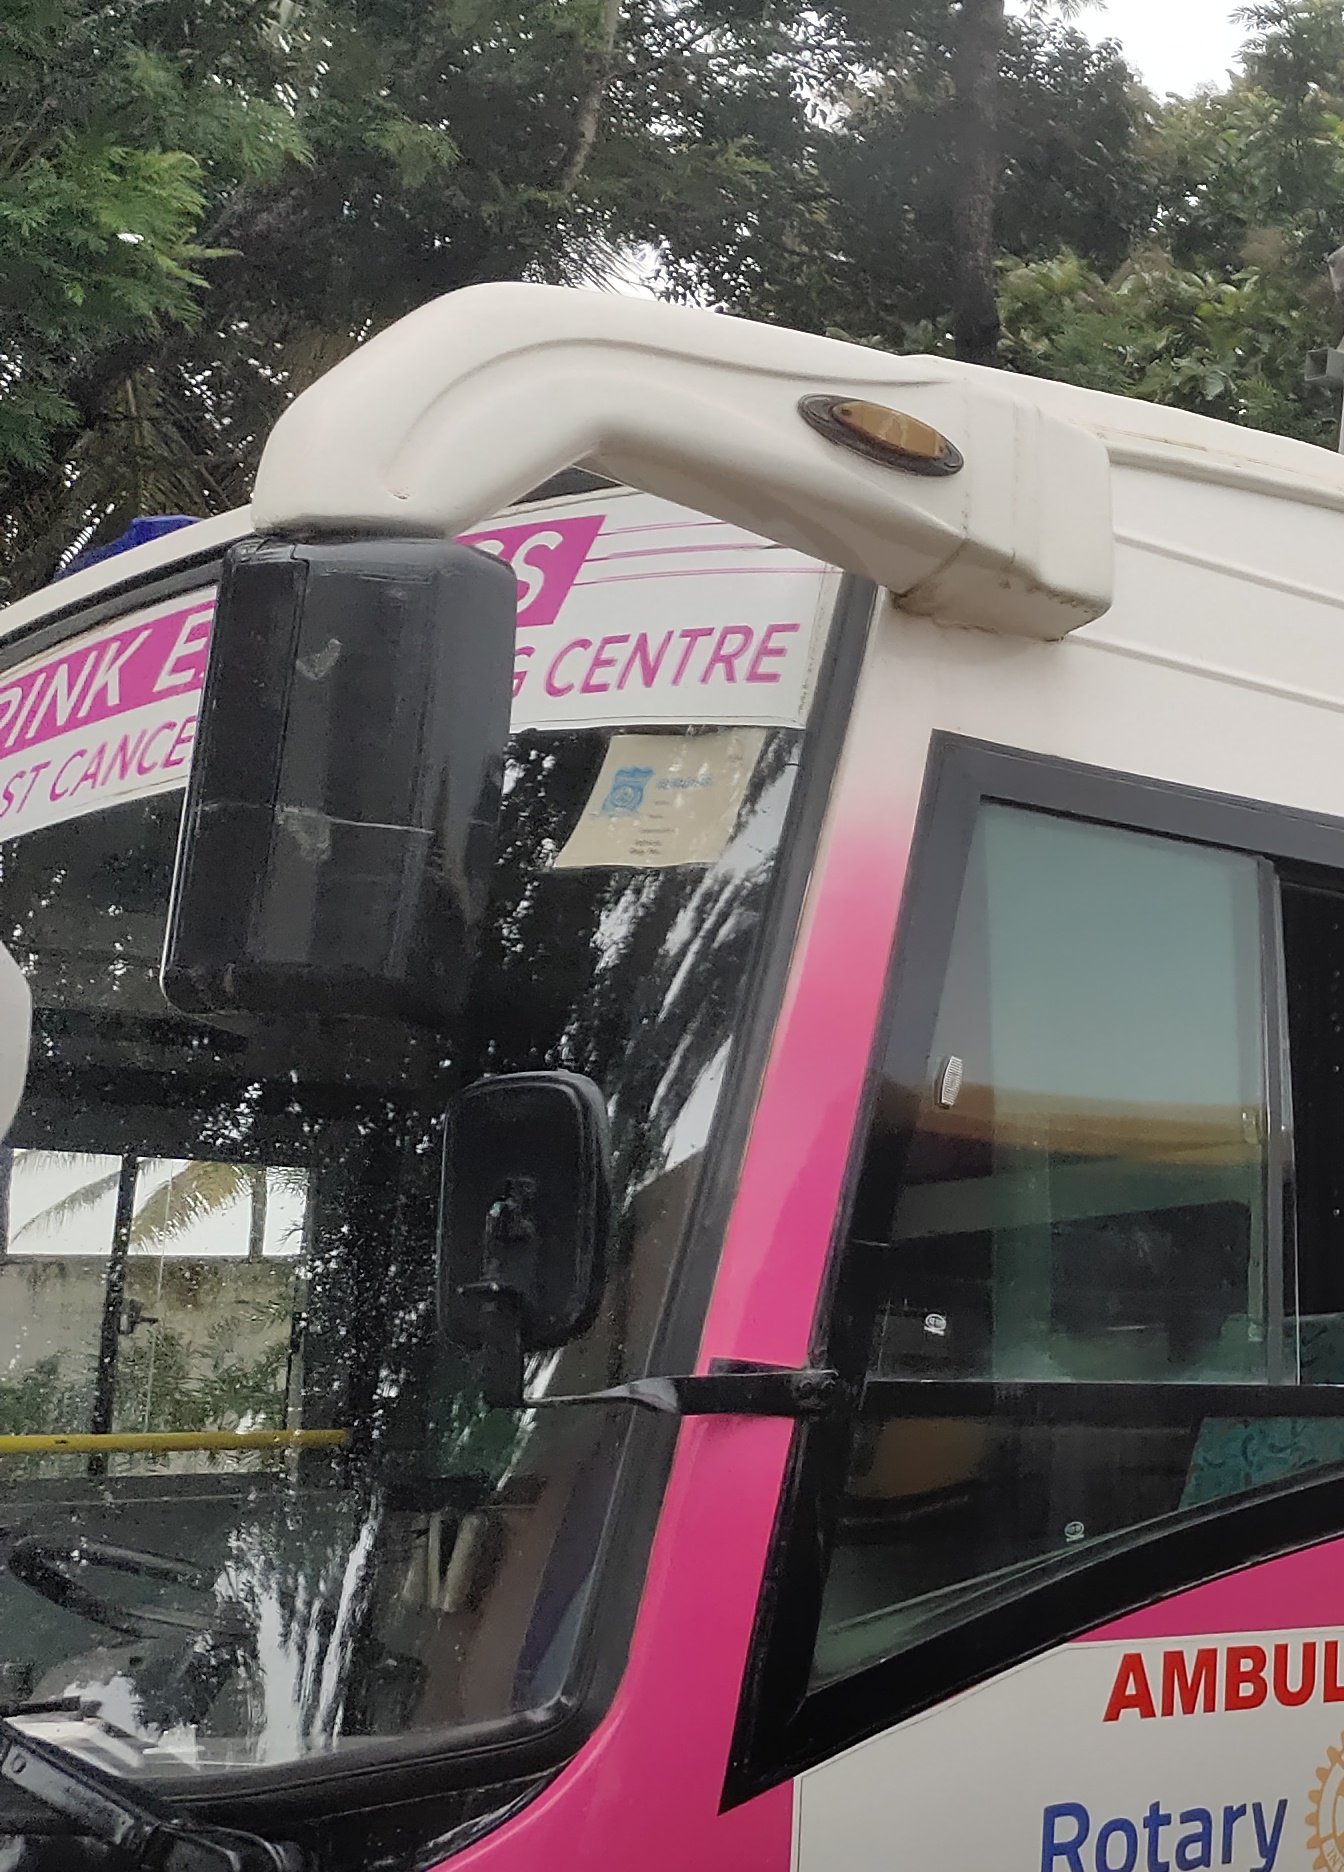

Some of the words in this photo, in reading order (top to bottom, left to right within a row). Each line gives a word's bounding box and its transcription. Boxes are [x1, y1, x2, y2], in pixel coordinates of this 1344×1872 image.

[543, 623, 801, 698] CENTRE
[49, 715, 198, 802] CANCE
[1040, 1798, 1289, 1872] Rotary
